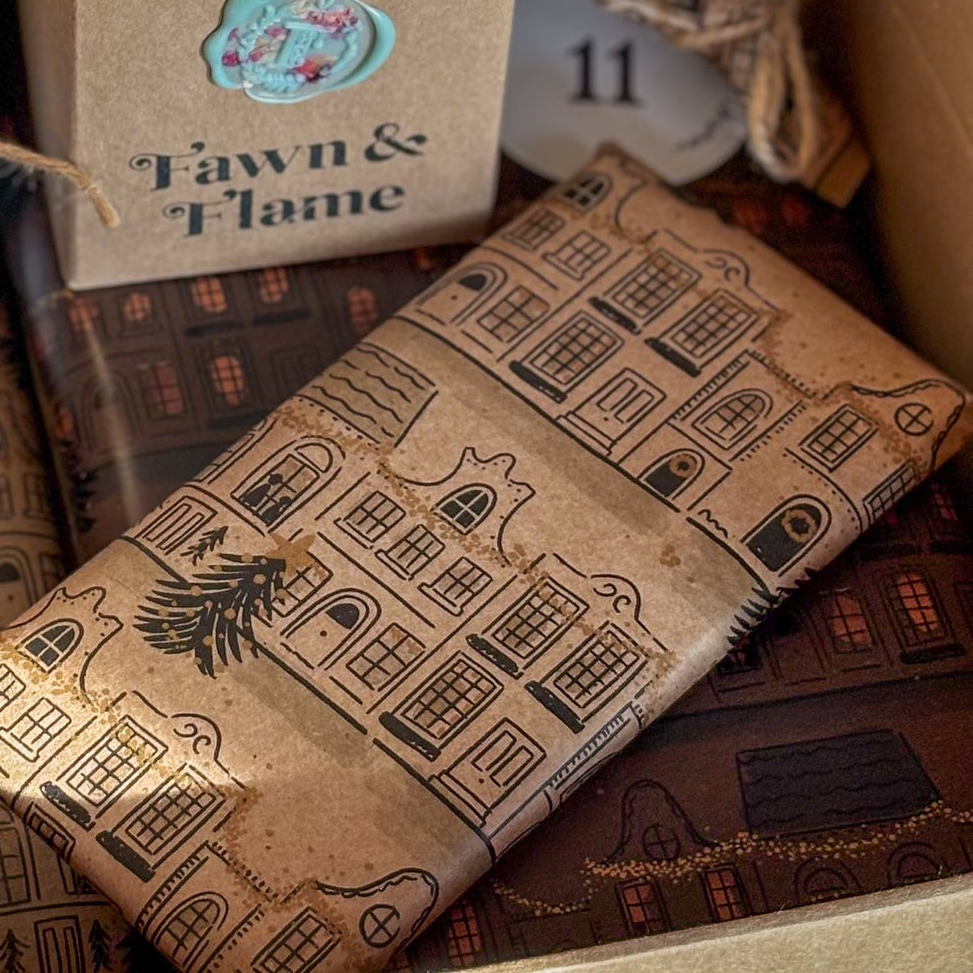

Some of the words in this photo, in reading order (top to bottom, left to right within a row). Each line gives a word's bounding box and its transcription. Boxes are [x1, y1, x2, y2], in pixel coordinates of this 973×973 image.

[567, 35, 644, 108] 11
[128, 140, 350, 193] Fawn
[364, 121, 428, 163] &
[162, 183, 407, 239] Flame
